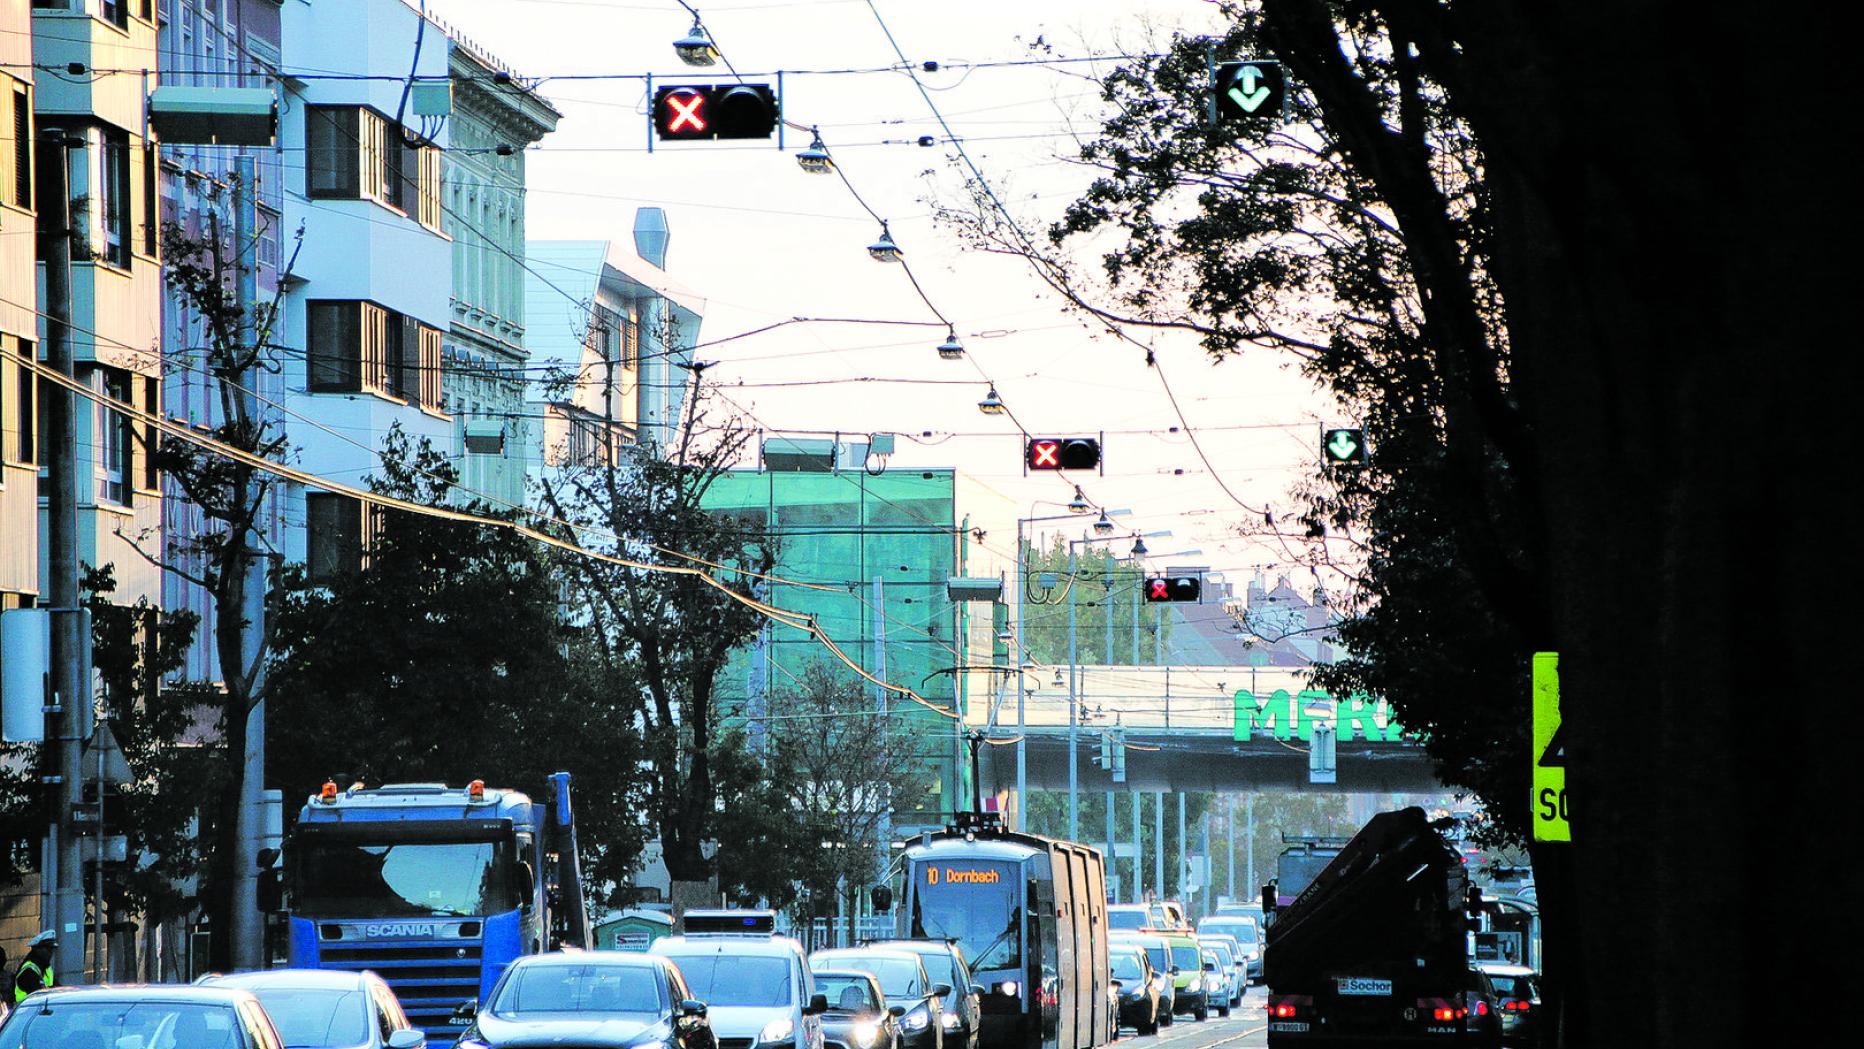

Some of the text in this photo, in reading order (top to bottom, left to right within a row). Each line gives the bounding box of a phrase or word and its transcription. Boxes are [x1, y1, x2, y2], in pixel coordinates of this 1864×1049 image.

[927, 867, 999, 885] 10 Dornbach
[366, 924, 432, 938] SCANIA
[1349, 980, 1391, 991] Sochor
